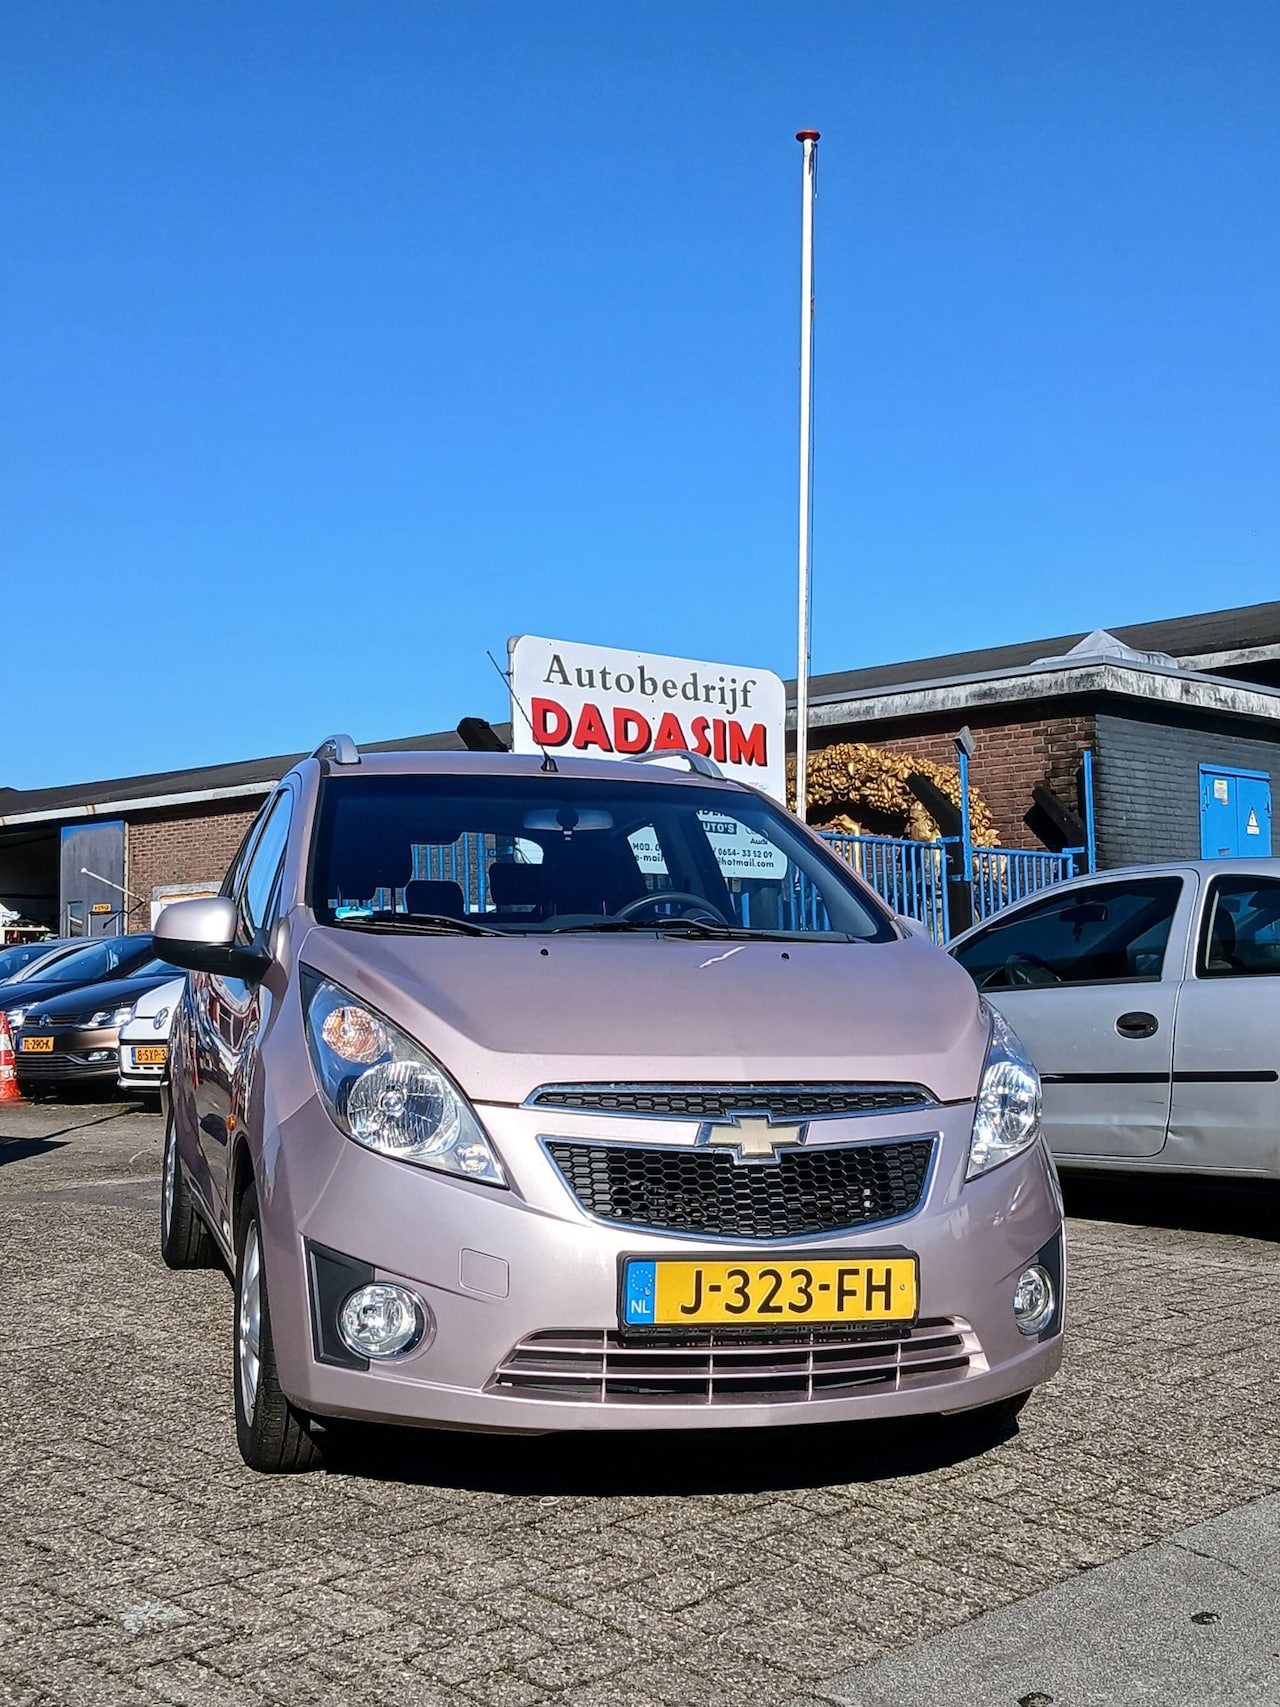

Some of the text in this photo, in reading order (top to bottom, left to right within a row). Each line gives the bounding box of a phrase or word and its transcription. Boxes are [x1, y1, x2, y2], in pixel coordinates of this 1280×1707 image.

[543, 654, 757, 715] Autobedrijf
[531, 697, 768, 767] DADASIM
[742, 849, 751, 857] 33
[631, 1300, 651, 1314] NL
[680, 1267, 892, 1315] J-323-FH
